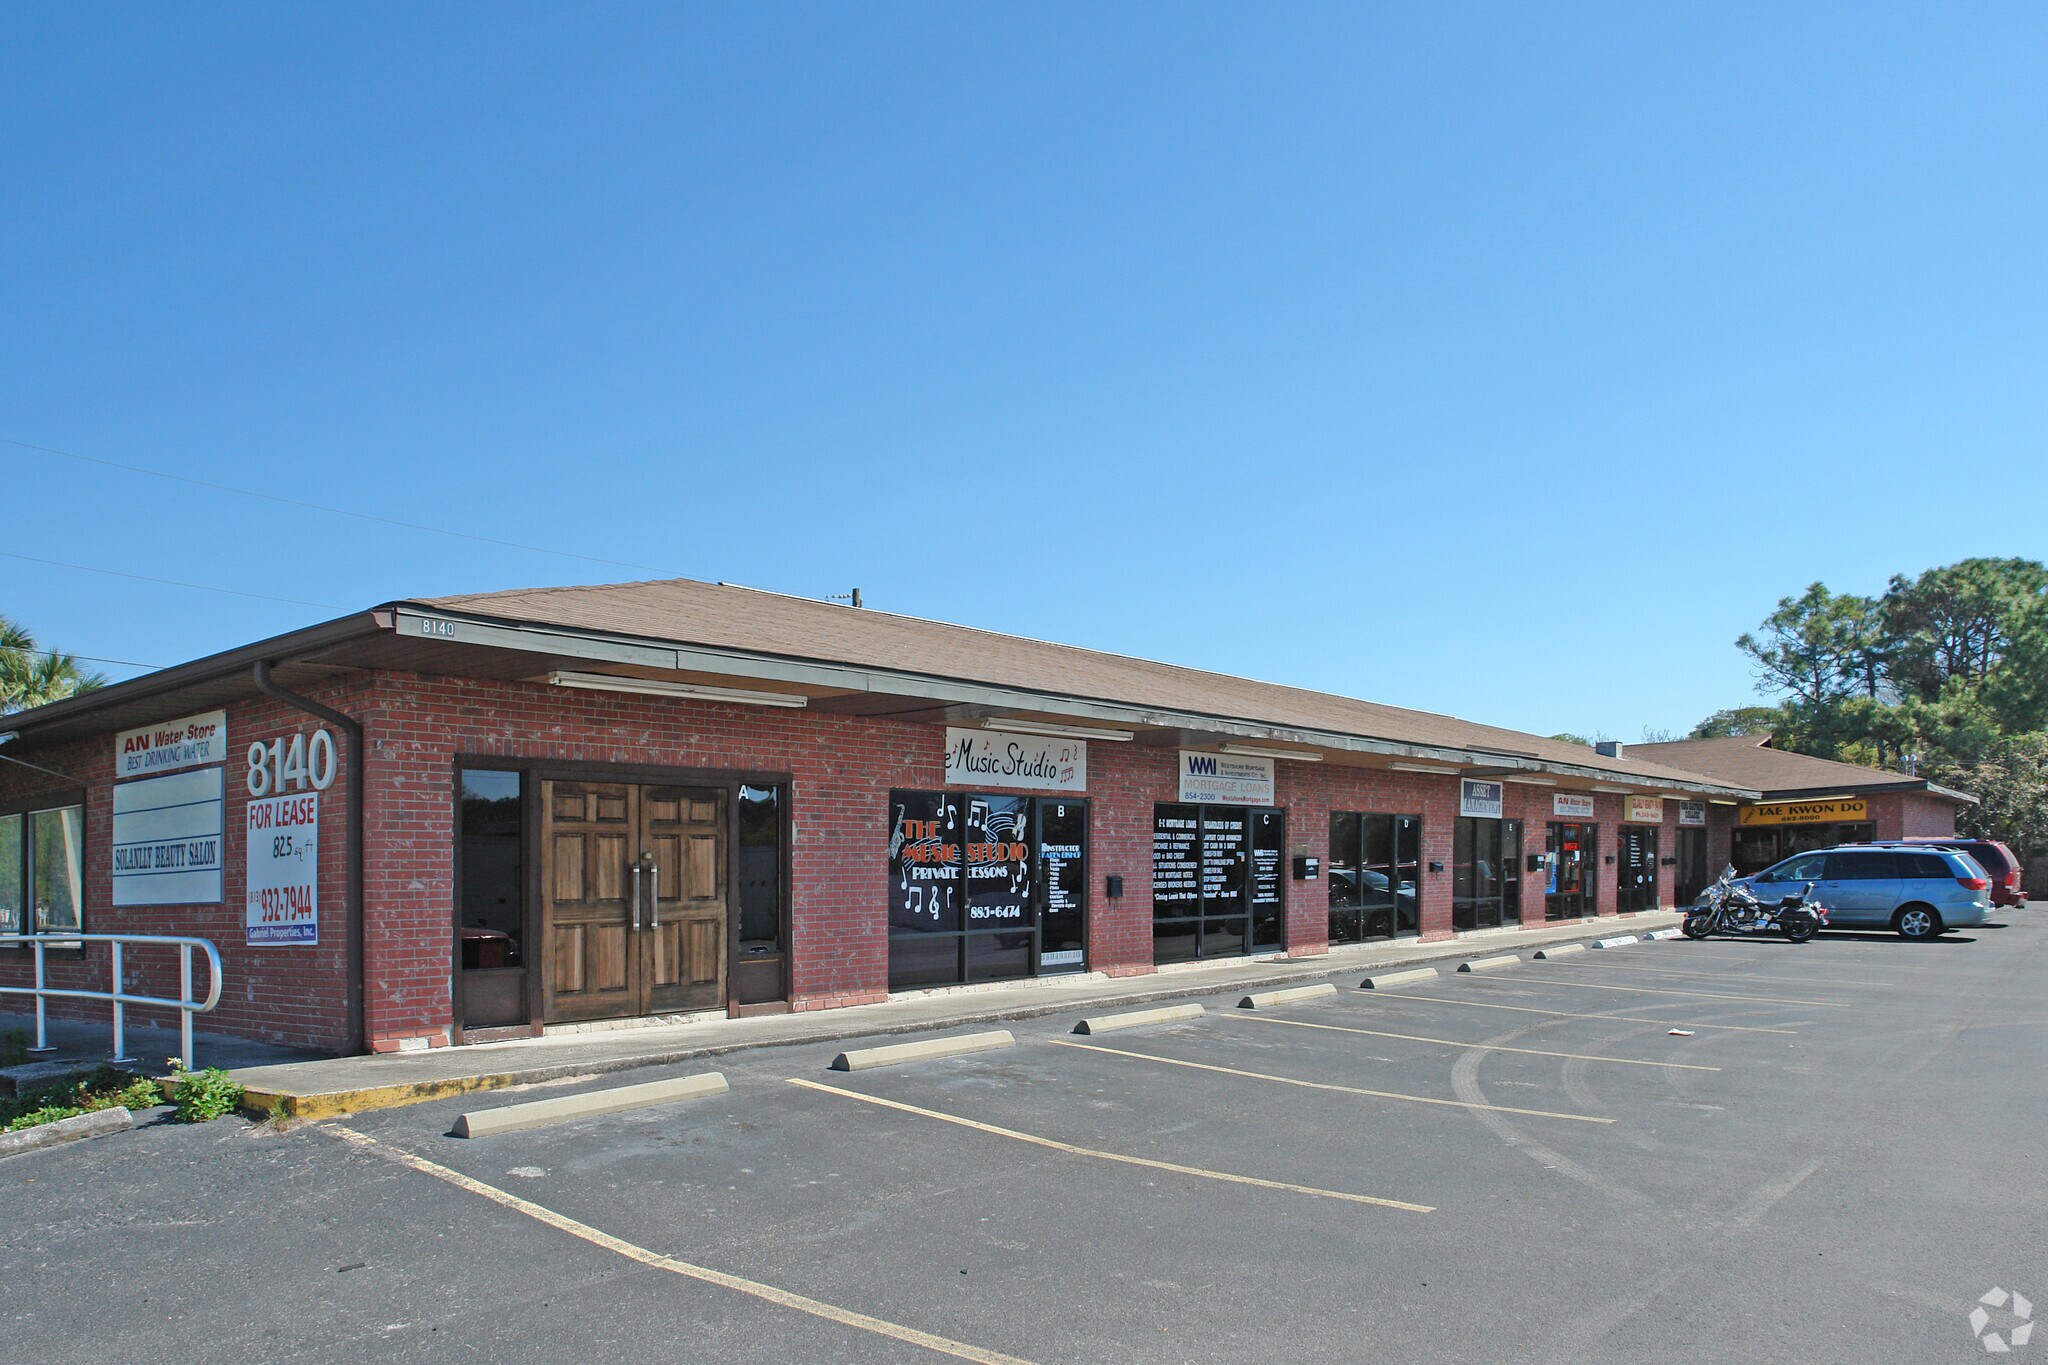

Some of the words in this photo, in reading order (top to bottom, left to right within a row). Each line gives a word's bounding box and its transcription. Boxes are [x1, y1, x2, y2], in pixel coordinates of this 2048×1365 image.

[423, 620, 454, 635] 8140
[124, 734, 150, 754] AN
[155, 730, 184, 748] Water
[187, 724, 216, 741] Store
[127, 753, 143, 771] BEST
[145, 746, 181, 768] DRINKING
[184, 741, 210, 760] WATER
[247, 729, 338, 797] 8140
[956, 738, 1000, 774] Music
[1001, 742, 1057, 779] Studio
[1188, 755, 1217, 775] WMI
[739, 784, 749, 800] A
[1184, 779, 1237, 792] MORTGAGE
[1240, 783, 1270, 794] LOANS
[1472, 783, 1491, 798] ASSET
[1184, 792, 1216, 801] 854-2300
[1558, 796, 1569, 805] AN
[249, 803, 272, 830] FOR
[275, 797, 315, 828] LEASE
[1057, 805, 1065, 818] B
[1463, 798, 1501, 815] MANAGEMENT
[1757, 805, 1783, 816] TAE
[1788, 803, 1835, 815] KWON
[1841, 802, 1865, 813] DO
[1263, 814, 1269, 825] C
[1404, 819, 1409, 828] D
[1509, 823, 1513, 832] E
[902, 819, 941, 840] THE
[155, 843, 187, 869] BEAUTY
[189, 841, 217, 866] SALON
[273, 836, 293, 859] 825
[902, 843, 960, 863] MUSIC
[967, 842, 1029, 862] STUDIO
[912, 866, 959, 880] PRIVATE
[967, 865, 1008, 879] LESSONS
[261, 885, 312, 922] 932-7944
[249, 927, 269, 939] Gabriel
[270, 926, 302, 940] Properties,
[303, 926, 315, 937] Inc.
